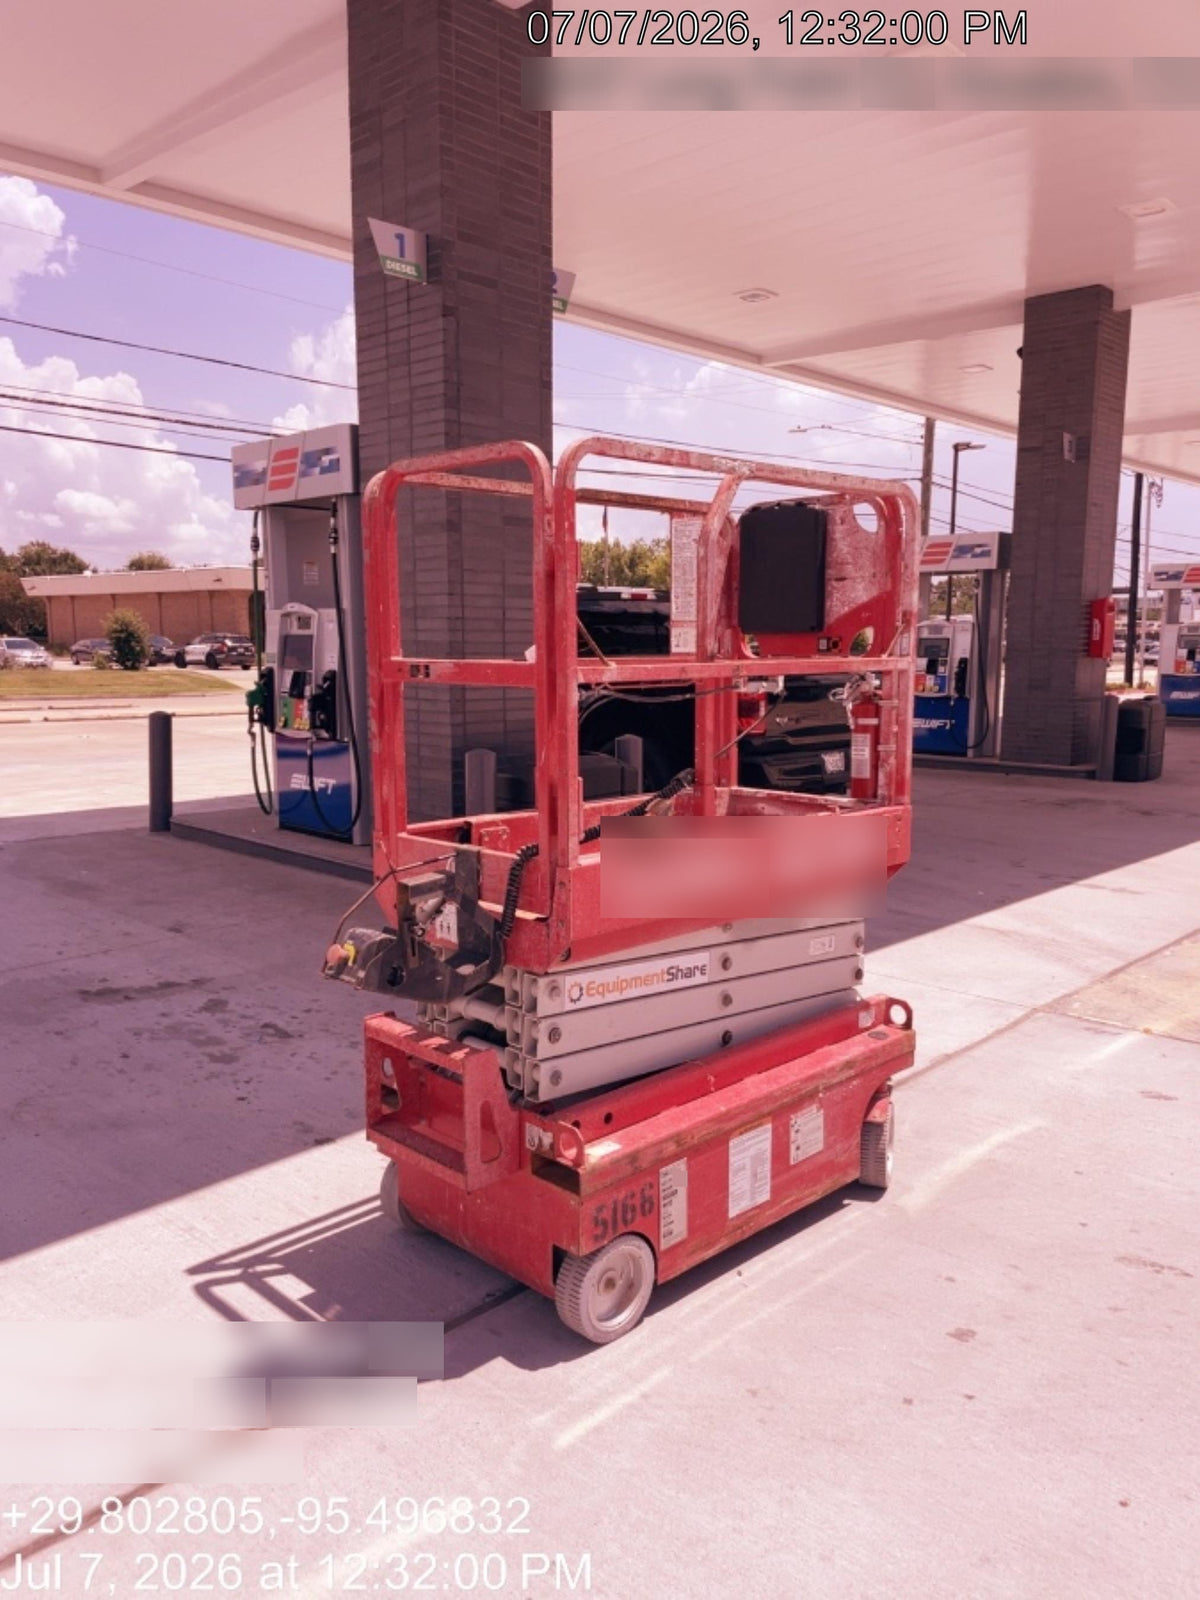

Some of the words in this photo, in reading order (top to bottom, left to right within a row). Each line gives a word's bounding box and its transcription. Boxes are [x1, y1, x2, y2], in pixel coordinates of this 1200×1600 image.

[393, 232, 406, 258] 1
[386, 259, 419, 276] DIESEL
[585, 963, 708, 998] EquipmentShare
[592, 1181, 655, 1243] 5166
